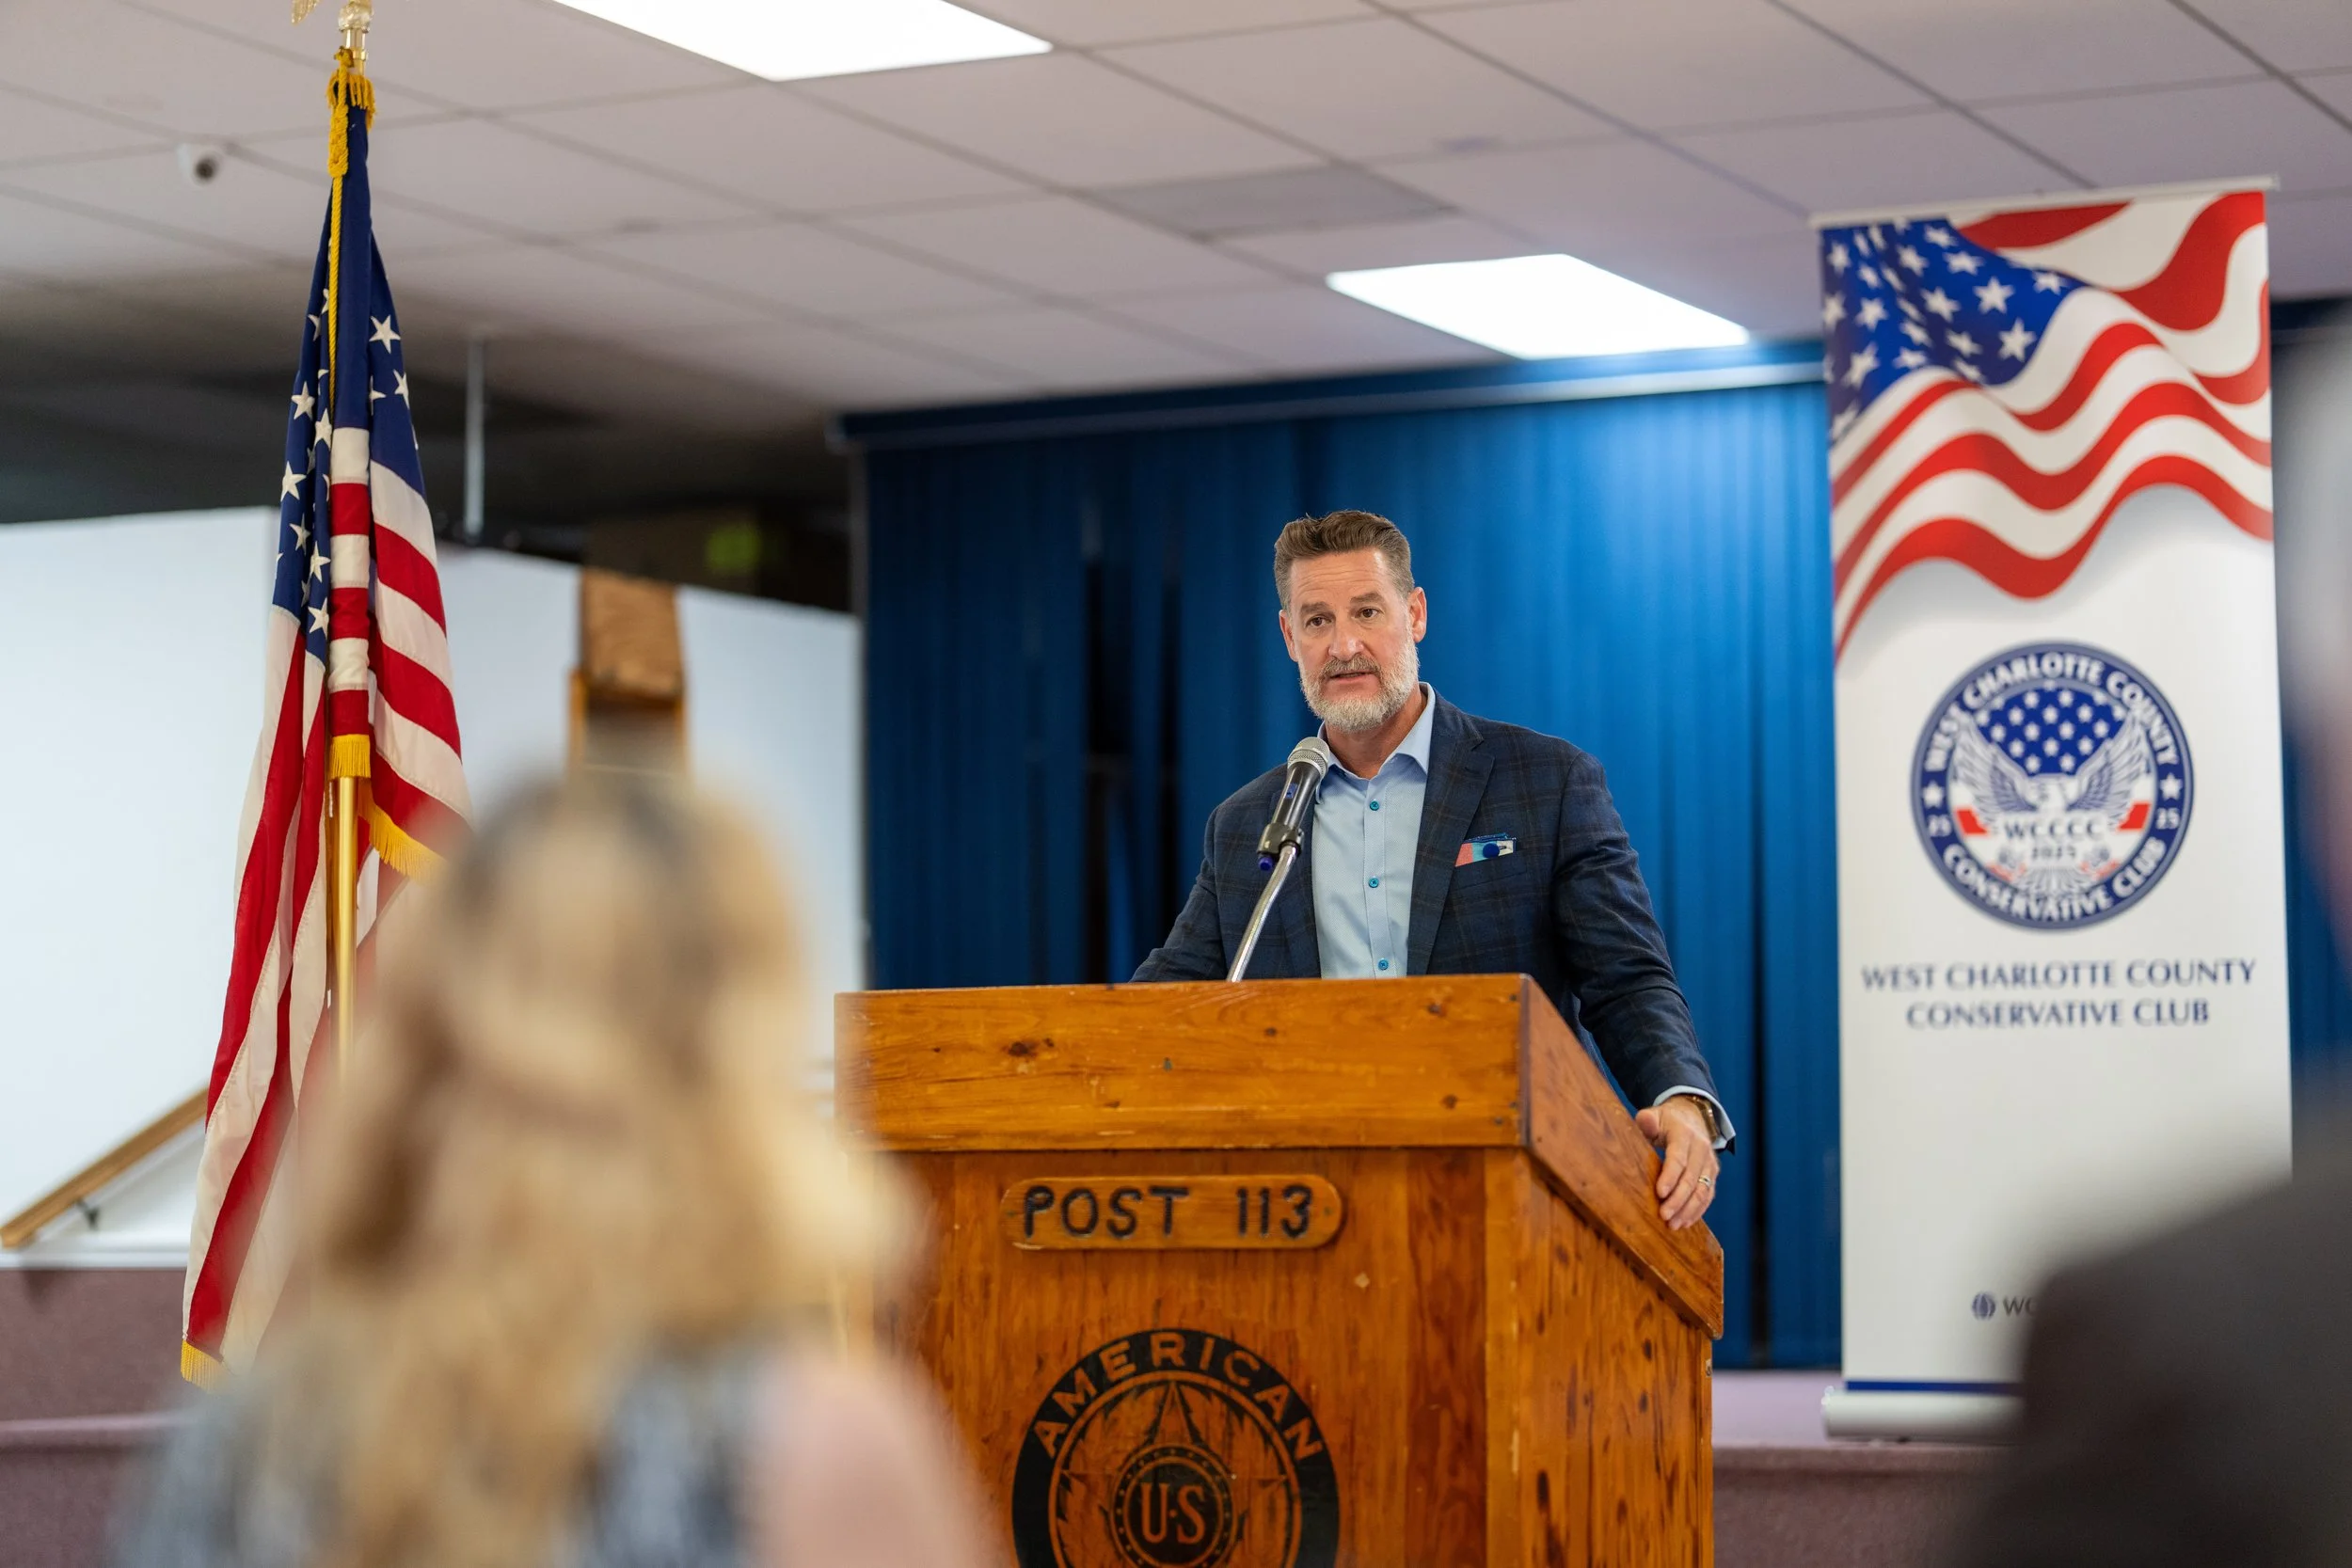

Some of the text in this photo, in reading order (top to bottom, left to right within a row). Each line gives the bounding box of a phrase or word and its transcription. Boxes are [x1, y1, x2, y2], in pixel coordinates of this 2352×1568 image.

[1925, 653, 2180, 771] WEST CHARLOTTE COUNTY
[2003, 816, 2105, 841] WCCCC
[1943, 836, 2167, 922] CONSERVATIVE CLUB
[1862, 958, 2257, 991] WEST CHARLOTTE COUNTY
[1906, 997, 2210, 1029] CONSERVATIVE CLUB
[1024, 1184, 1313, 1239] POST 113
[1035, 1331, 1324, 1460] AMERICAN
